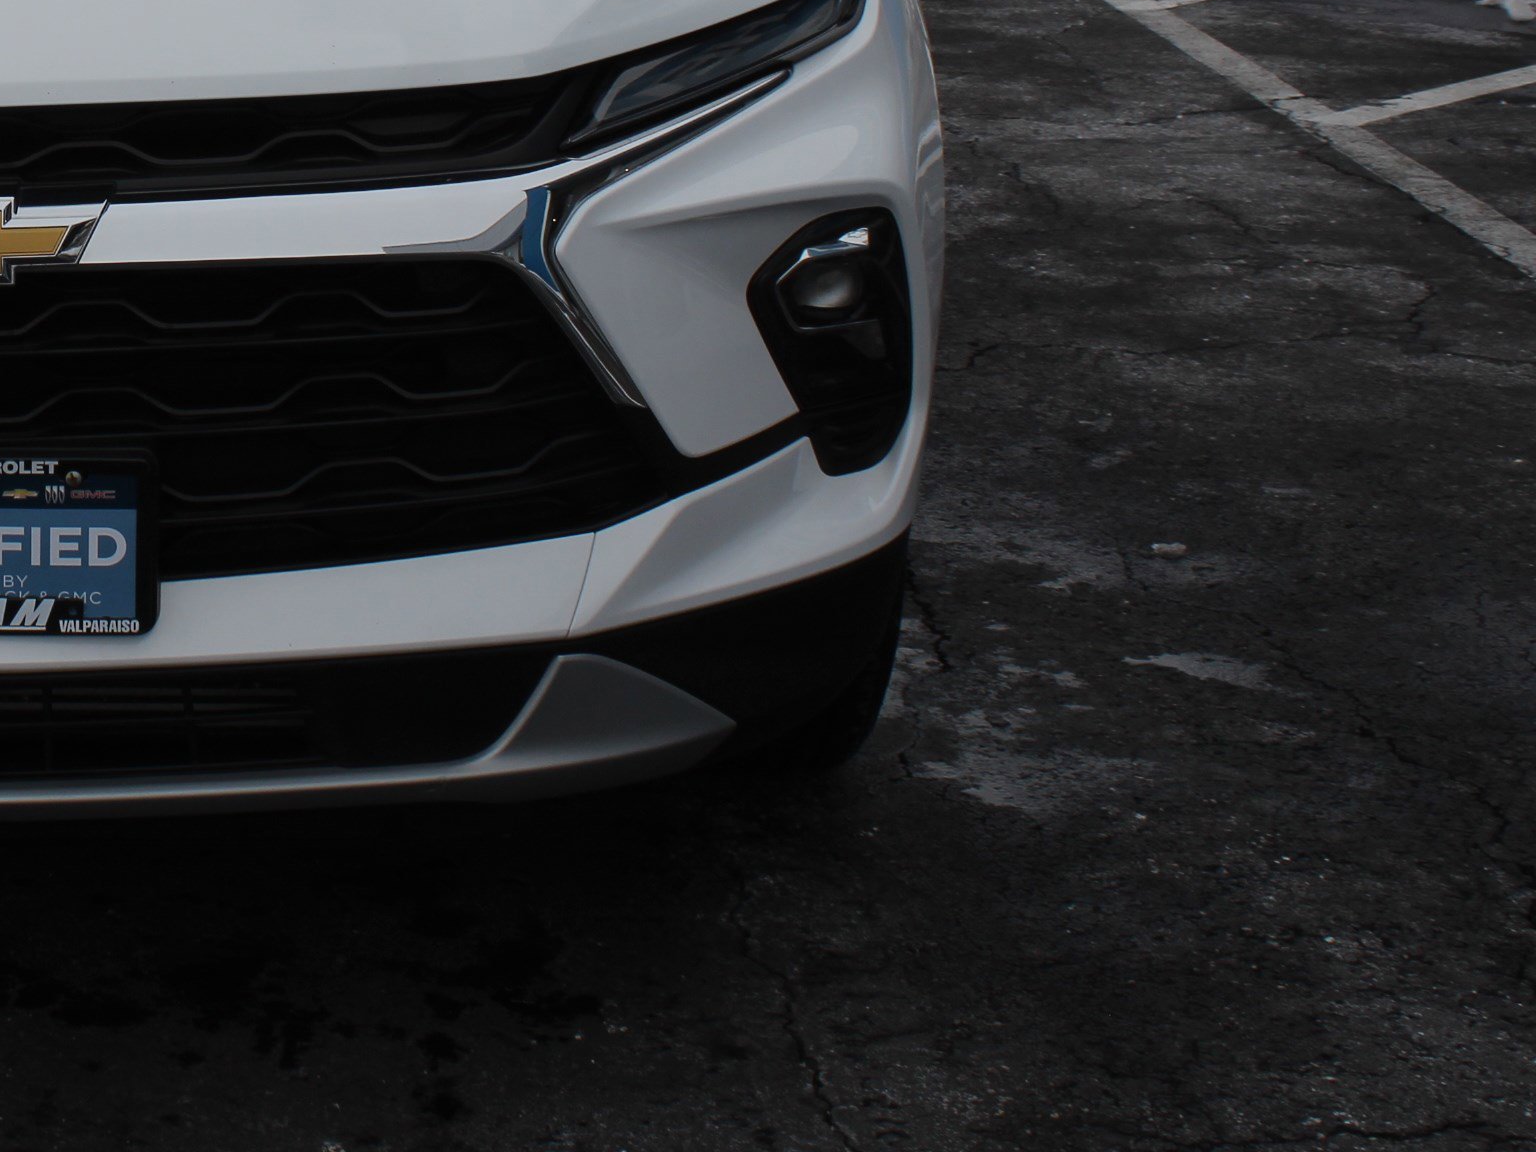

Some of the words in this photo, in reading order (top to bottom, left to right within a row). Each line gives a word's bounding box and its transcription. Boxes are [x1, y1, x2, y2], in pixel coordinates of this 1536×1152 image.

[70, 490, 116, 499] GMC
[3, 574, 28, 588] BY
[58, 619, 140, 633] VALPARAISO
